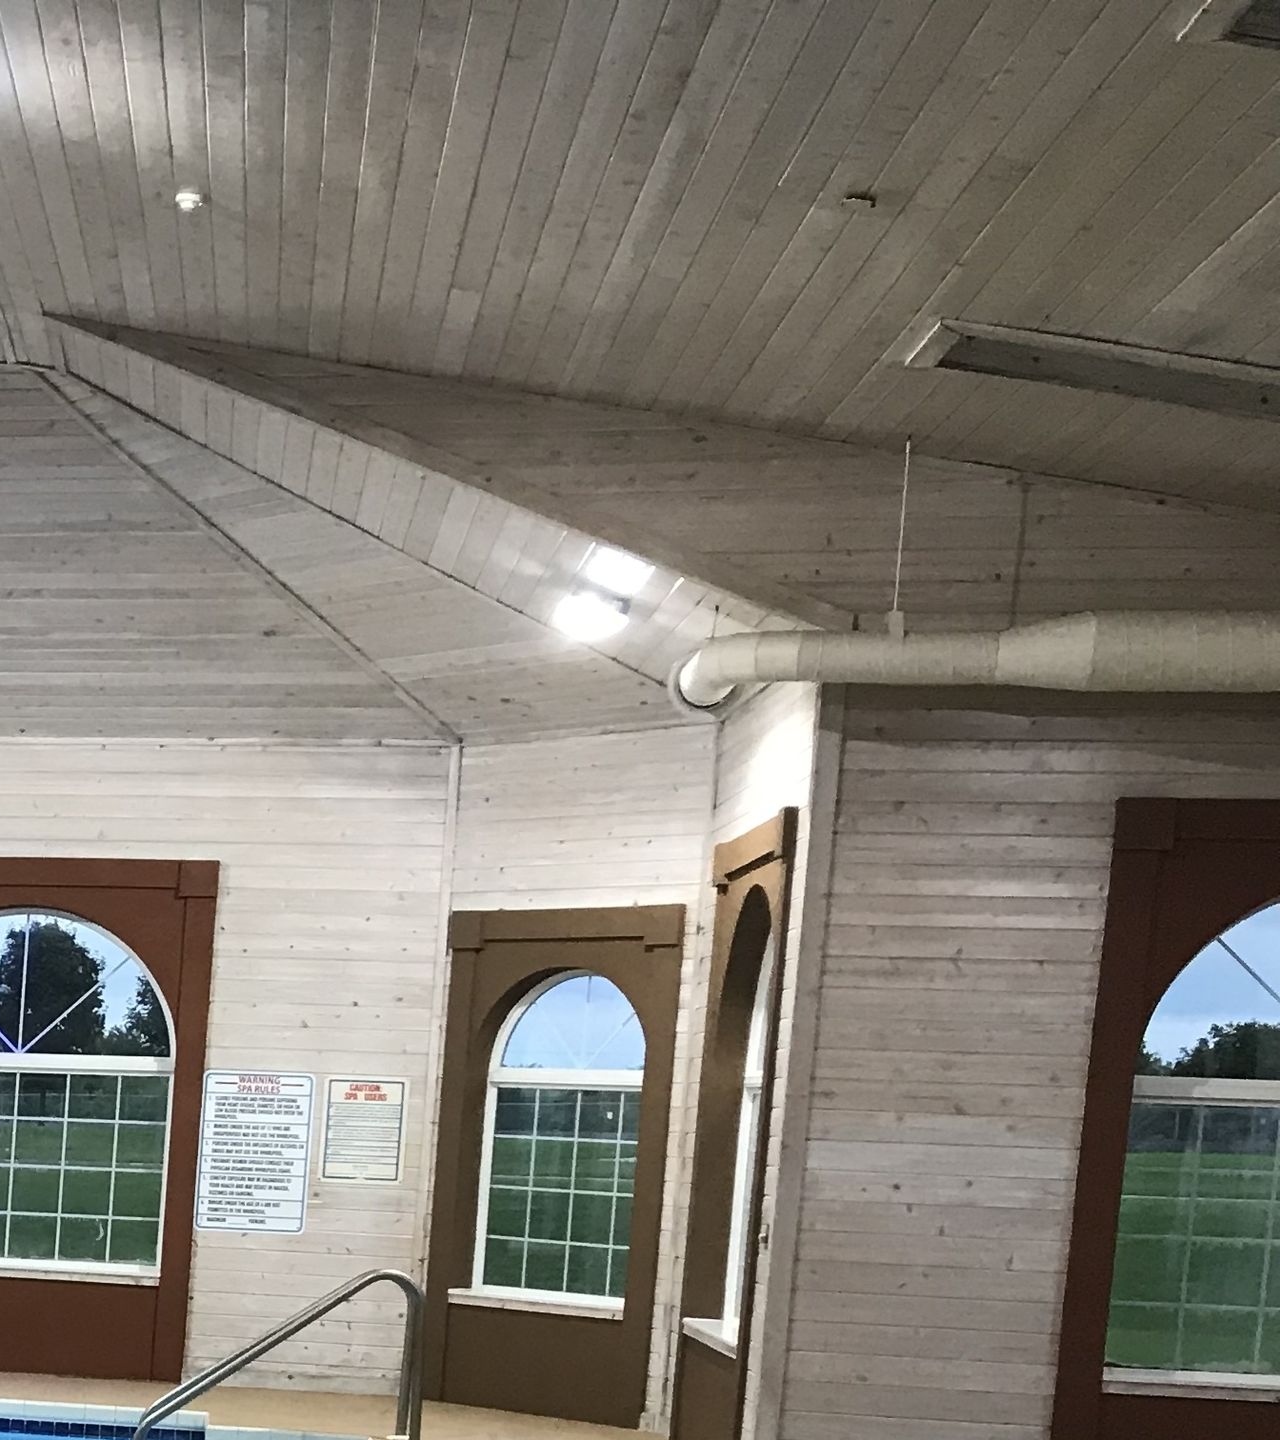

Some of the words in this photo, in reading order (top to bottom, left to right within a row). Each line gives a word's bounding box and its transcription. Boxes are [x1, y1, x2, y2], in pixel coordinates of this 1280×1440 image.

[238, 1075, 281, 1085] WARNING
[237, 1085, 252, 1093] SPA
[254, 1086, 281, 1095] RULES
[344, 1092, 358, 1101] SPA
